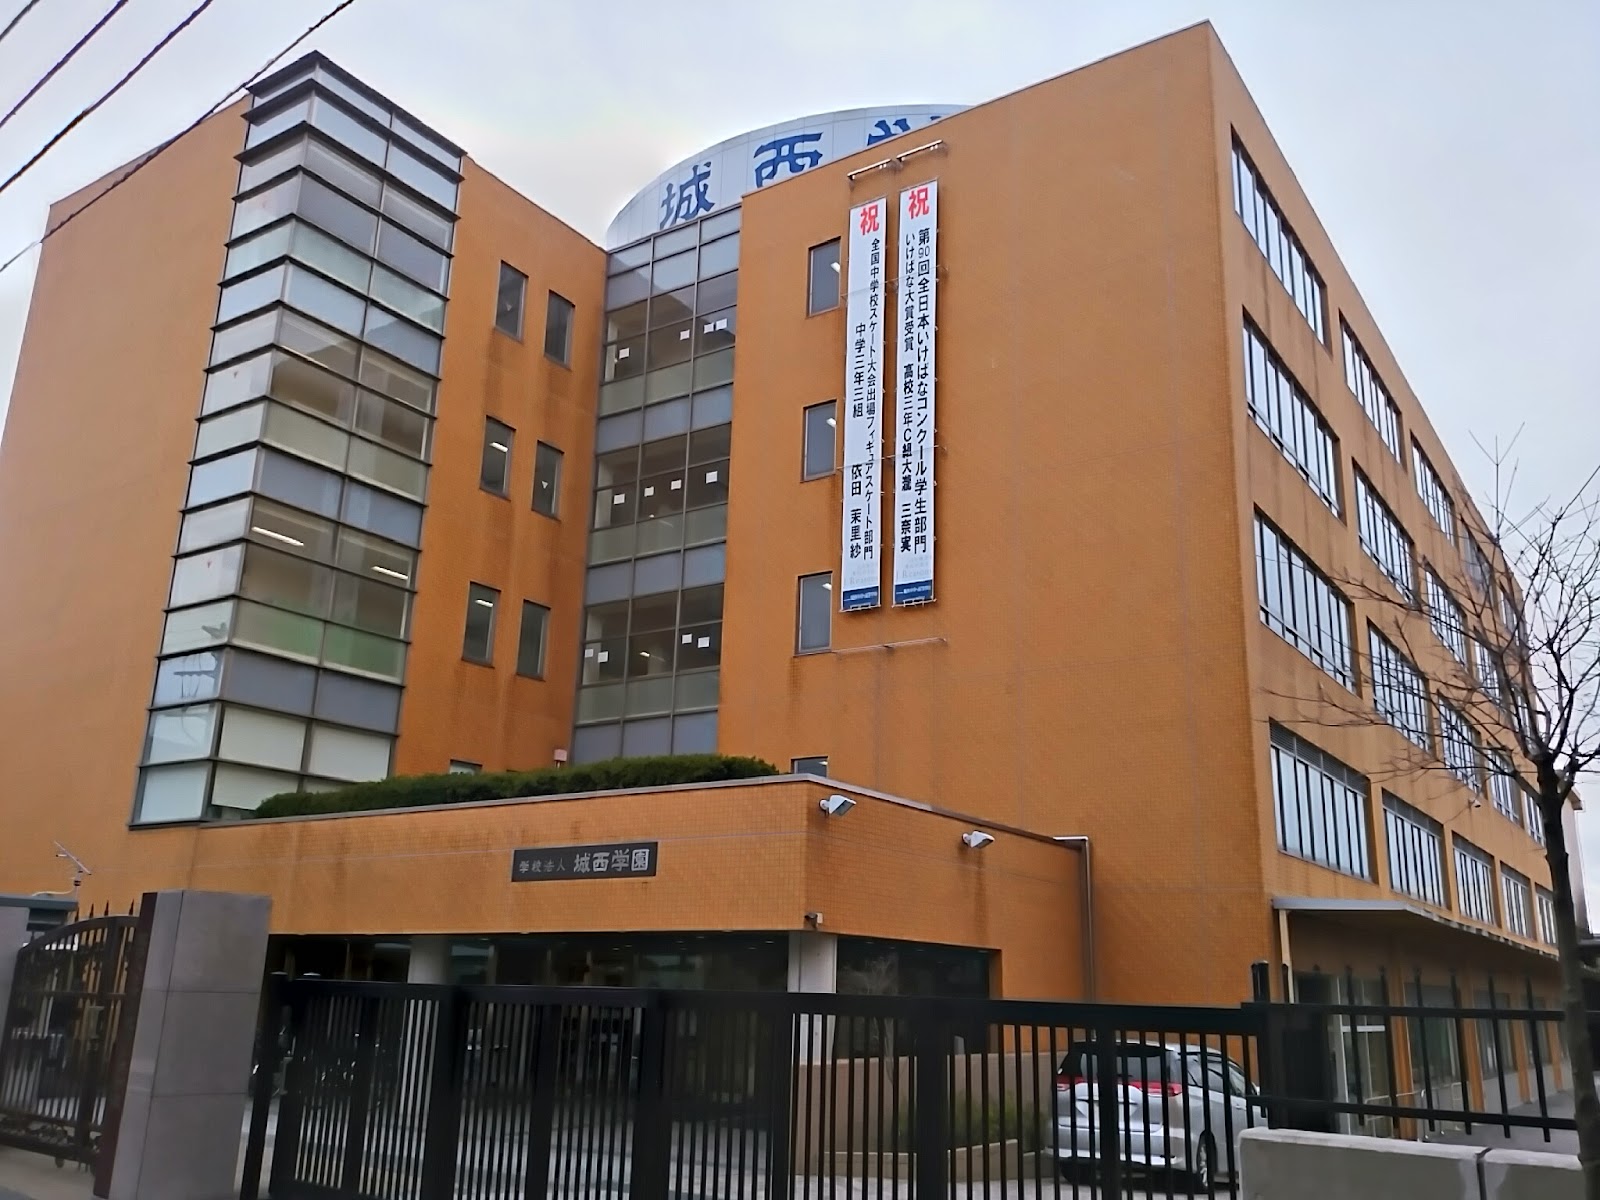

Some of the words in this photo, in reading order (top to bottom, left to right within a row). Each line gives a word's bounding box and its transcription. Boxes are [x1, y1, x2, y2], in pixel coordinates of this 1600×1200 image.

[860, 204, 880, 236] 祝
[908, 187, 929, 220] 祝
[904, 233, 915, 353] いけばな大賞受賞
[852, 322, 866, 418] 中学三年三組
[914, 227, 931, 554] 第90回全日本いけばなコンクール学生部門
[851, 464, 862, 497] 依田
[519, 859, 566, 874] 学校法人
[574, 848, 649, 873] 城西学園
